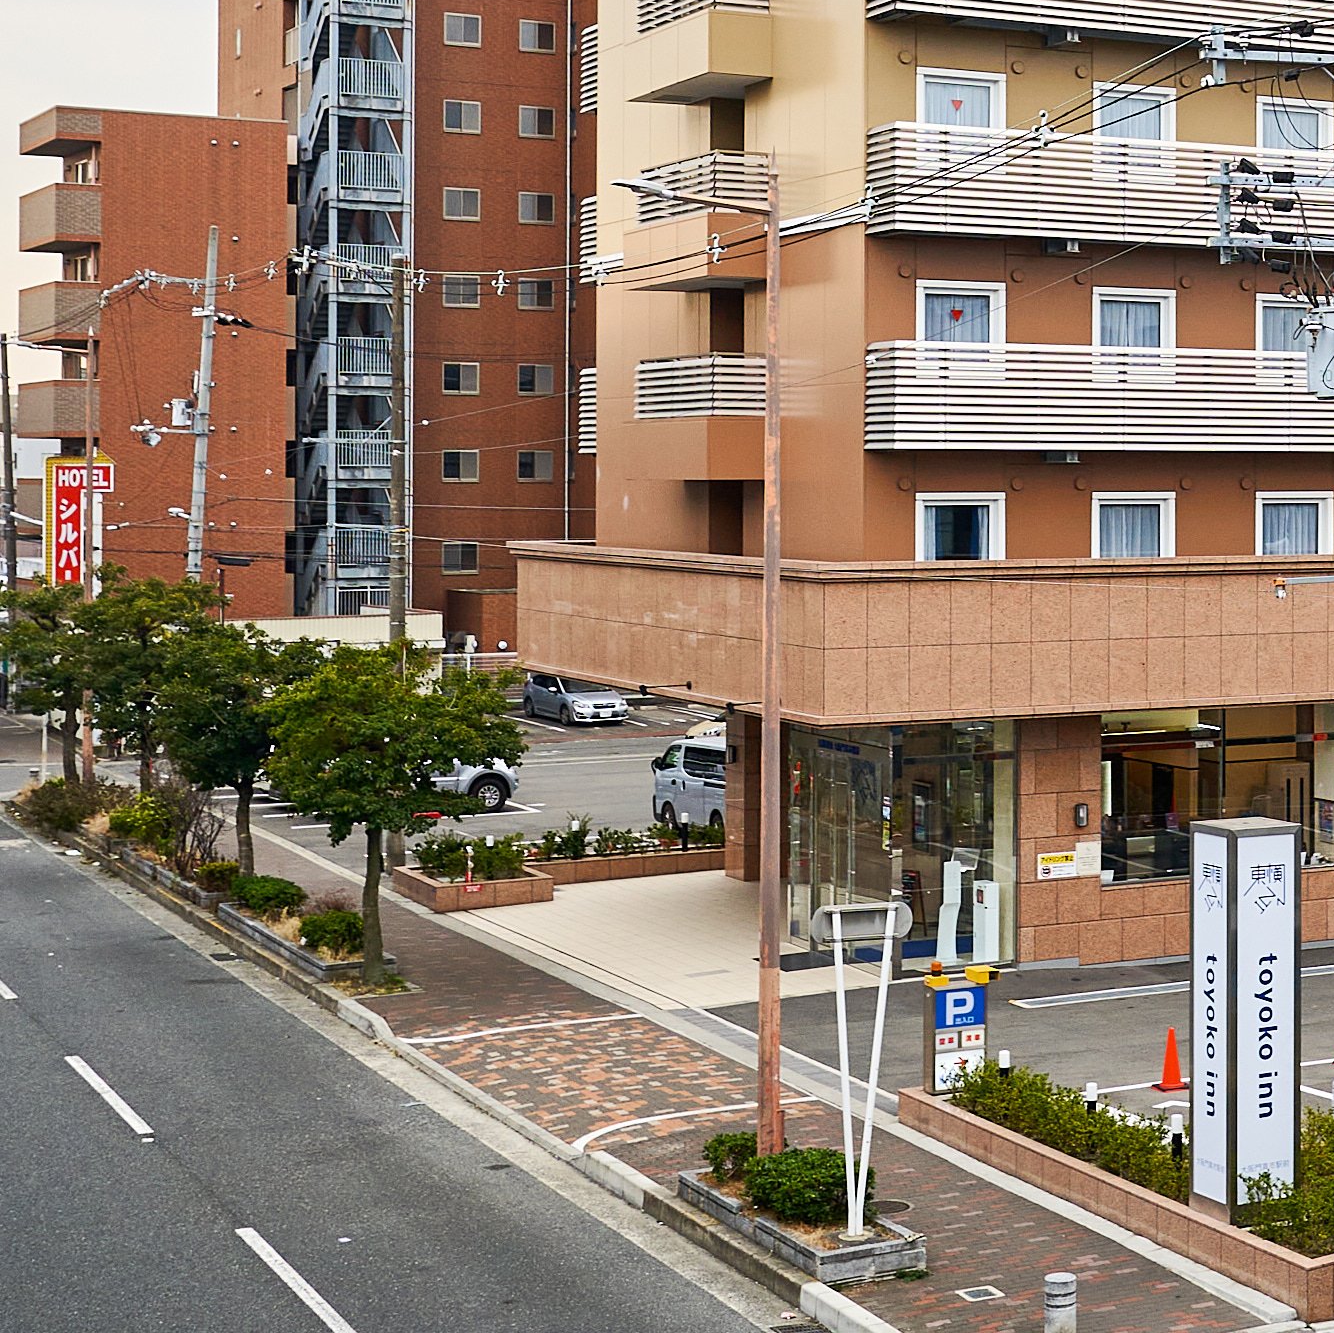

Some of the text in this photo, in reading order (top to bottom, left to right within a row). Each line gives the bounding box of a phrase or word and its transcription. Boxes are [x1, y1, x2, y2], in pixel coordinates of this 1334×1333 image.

[58, 468, 109, 488] HOTEL
[945, 990, 975, 1026] P
[1203, 953, 1218, 1117] toyoko inn
[1253, 952, 1278, 1119] toyoko inn
